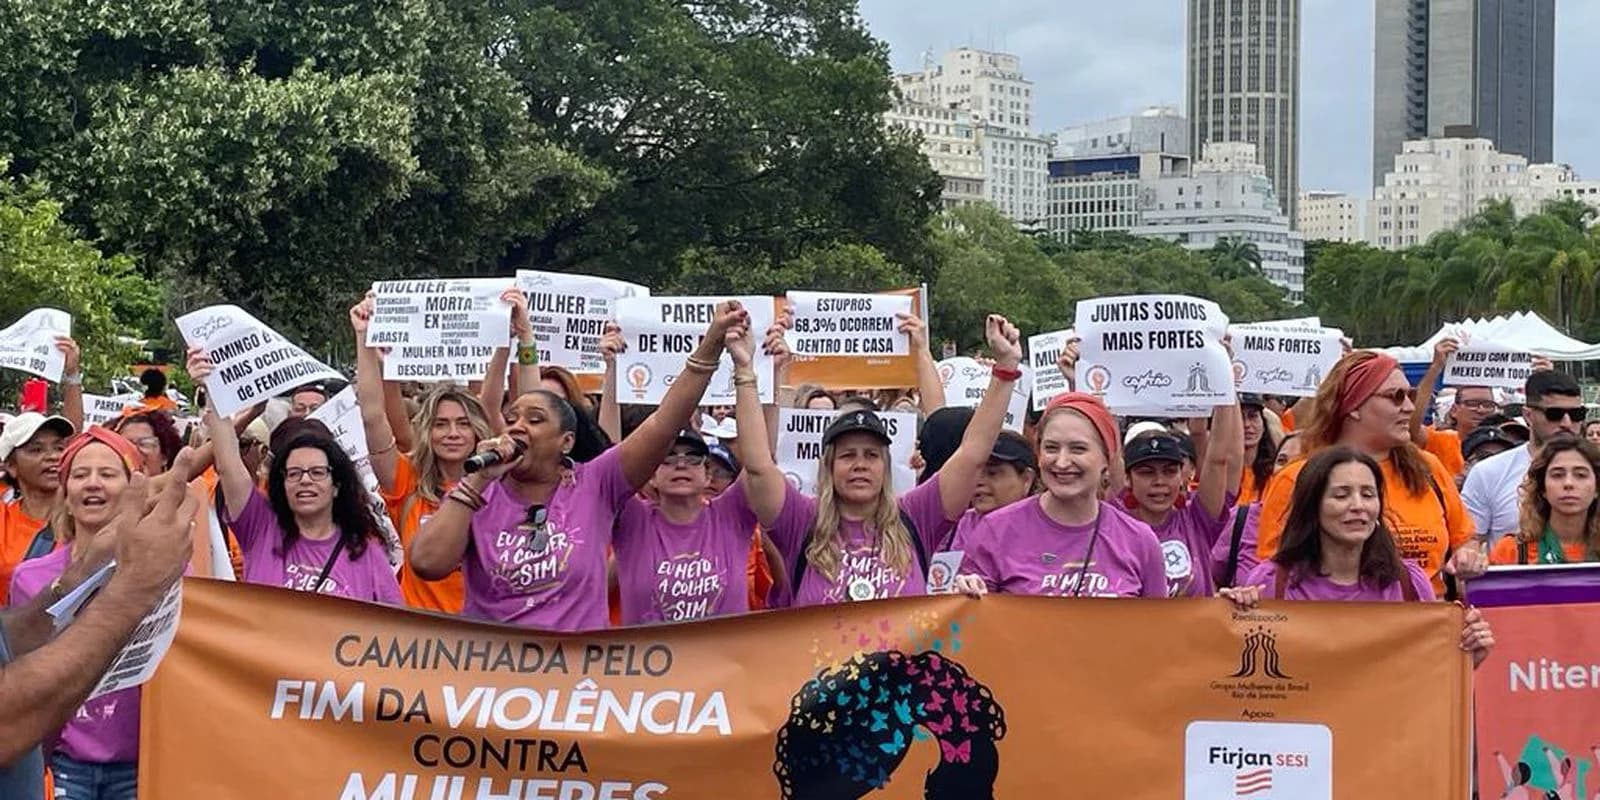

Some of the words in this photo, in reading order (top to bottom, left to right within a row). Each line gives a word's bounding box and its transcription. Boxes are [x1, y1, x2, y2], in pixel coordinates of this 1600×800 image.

[426, 296, 473, 311] MORTA
[816, 298, 873, 312] ESTUPROS
[1090, 302, 1149, 322] JUNTAS
[1154, 301, 1207, 321] SOMOS
[424, 314, 439, 328] EX
[840, 316, 894, 332] OCORREM
[371, 332, 409, 343] #BASTA
[565, 335, 579, 350] EX
[638, 335, 658, 353] DE
[663, 335, 694, 353] NOS
[796, 338, 842, 353] DENTRO
[845, 339, 860, 353] DE
[863, 338, 894, 353] CASA
[1102, 331, 1143, 351] MAIS
[1148, 329, 1205, 350] FORTES
[1243, 335, 1276, 352] MAIS
[1278, 337, 1322, 355] FORTES
[402, 346, 445, 358] MULHER
[1456, 352, 1487, 362] MEXEU
[1488, 352, 1510, 362] COM
[219, 359, 253, 386] MAIS
[398, 364, 452, 377] DESCULPA,
[455, 363, 477, 376] TEM
[1451, 366, 1482, 378] MEXEU
[1483, 366, 1505, 378] COM
[786, 414, 837, 434] JUNTA
[500, 549, 510, 563] A
[519, 553, 558, 587] SIM
[657, 560, 676, 576] EU
[658, 578, 669, 593] A
[671, 574, 721, 598] COLHER
[673, 598, 708, 622] SIM
[334, 633, 570, 676] CAMINHADA
[581, 644, 674, 678] PELO
[270, 679, 366, 722] FIM
[375, 687, 433, 724] DA
[442, 677, 733, 736] VIOLÊNCIA
[413, 733, 588, 773] CONTRA
[1209, 746, 1272, 769] Firjan
[1276, 753, 1309, 768] SESI
[338, 771, 669, 800] MULHERES
